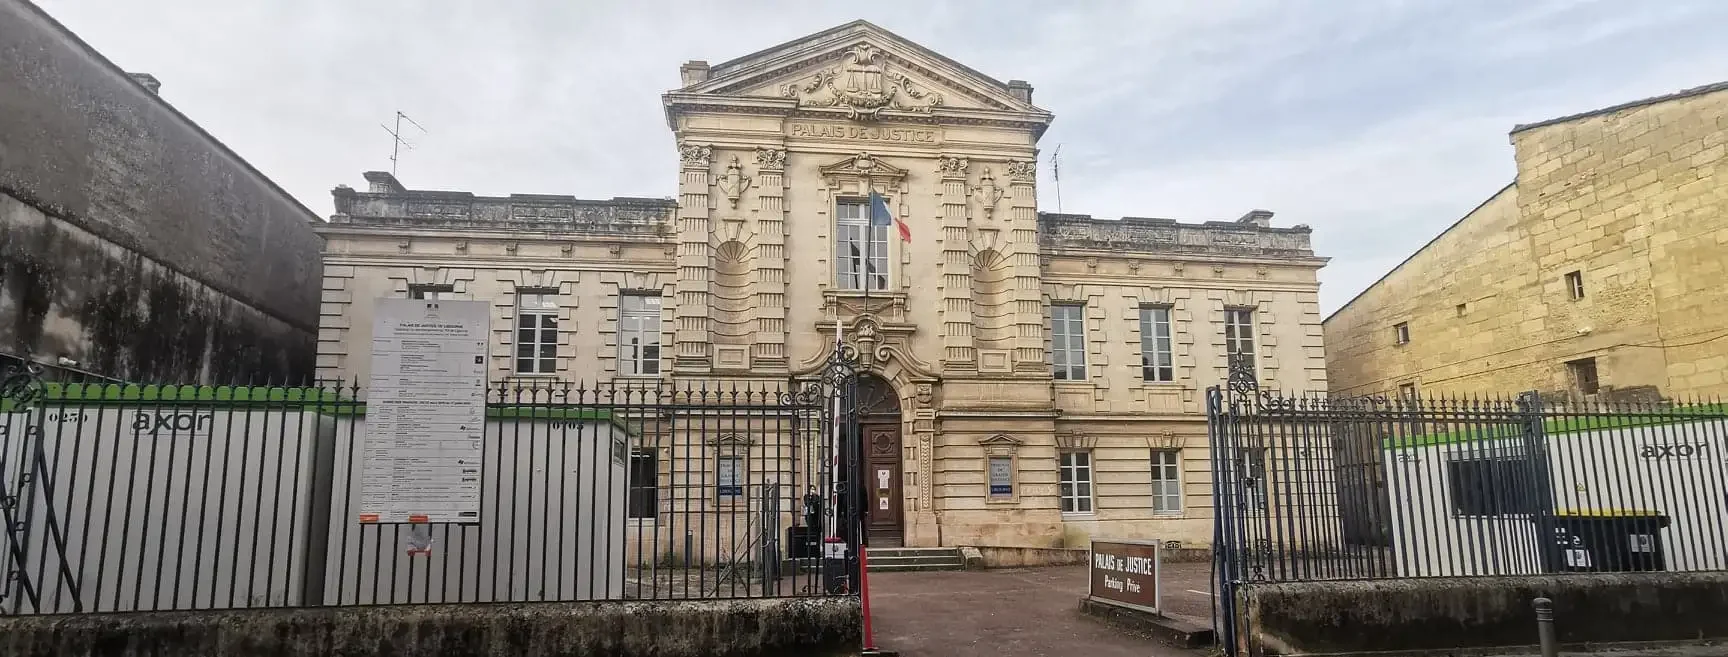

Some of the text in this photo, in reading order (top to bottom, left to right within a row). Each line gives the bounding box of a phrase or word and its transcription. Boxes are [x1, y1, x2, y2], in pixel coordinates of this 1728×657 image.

[792, 123, 935, 142] PALAIS DE JUSTICE
[132, 412, 212, 434] axor
[1641, 444, 1708, 459] axor
[1095, 553, 1152, 576] PALAIS DE JUSTICE
[1104, 574, 1124, 592] Parking
